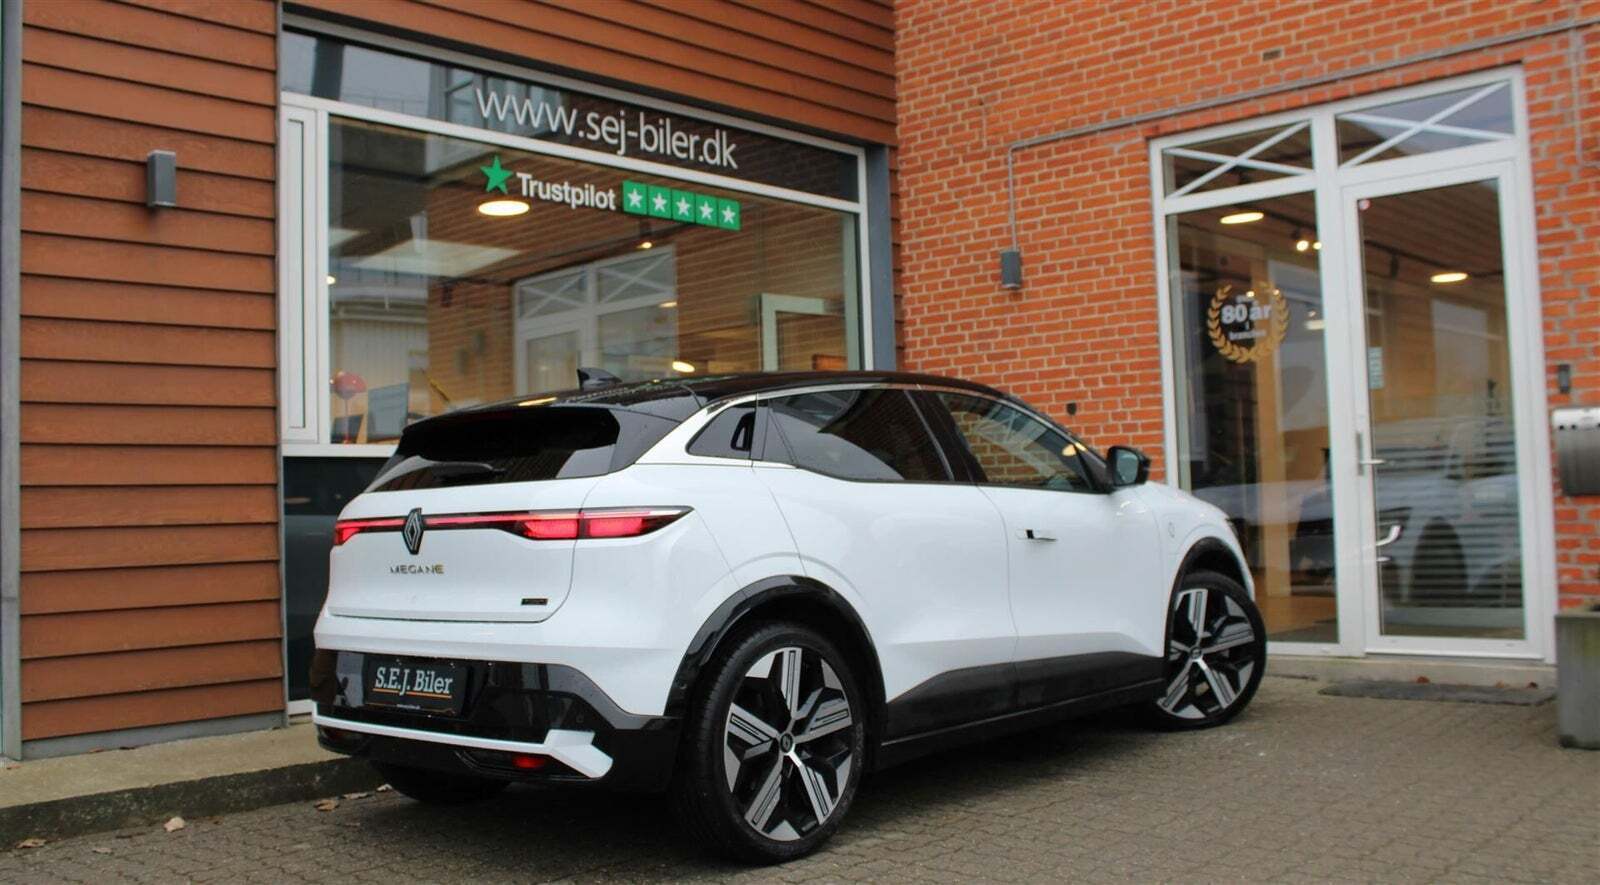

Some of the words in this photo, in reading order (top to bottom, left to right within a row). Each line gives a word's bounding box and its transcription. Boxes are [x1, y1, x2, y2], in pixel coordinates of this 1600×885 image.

[476, 87, 738, 169] www.sej-biler.dk
[516, 171, 616, 211] Trustpilot
[1221, 303, 1248, 324] 80
[390, 564, 445, 575] MEGANE
[374, 666, 411, 696] S.E.J.
[413, 669, 454, 694] Biler
